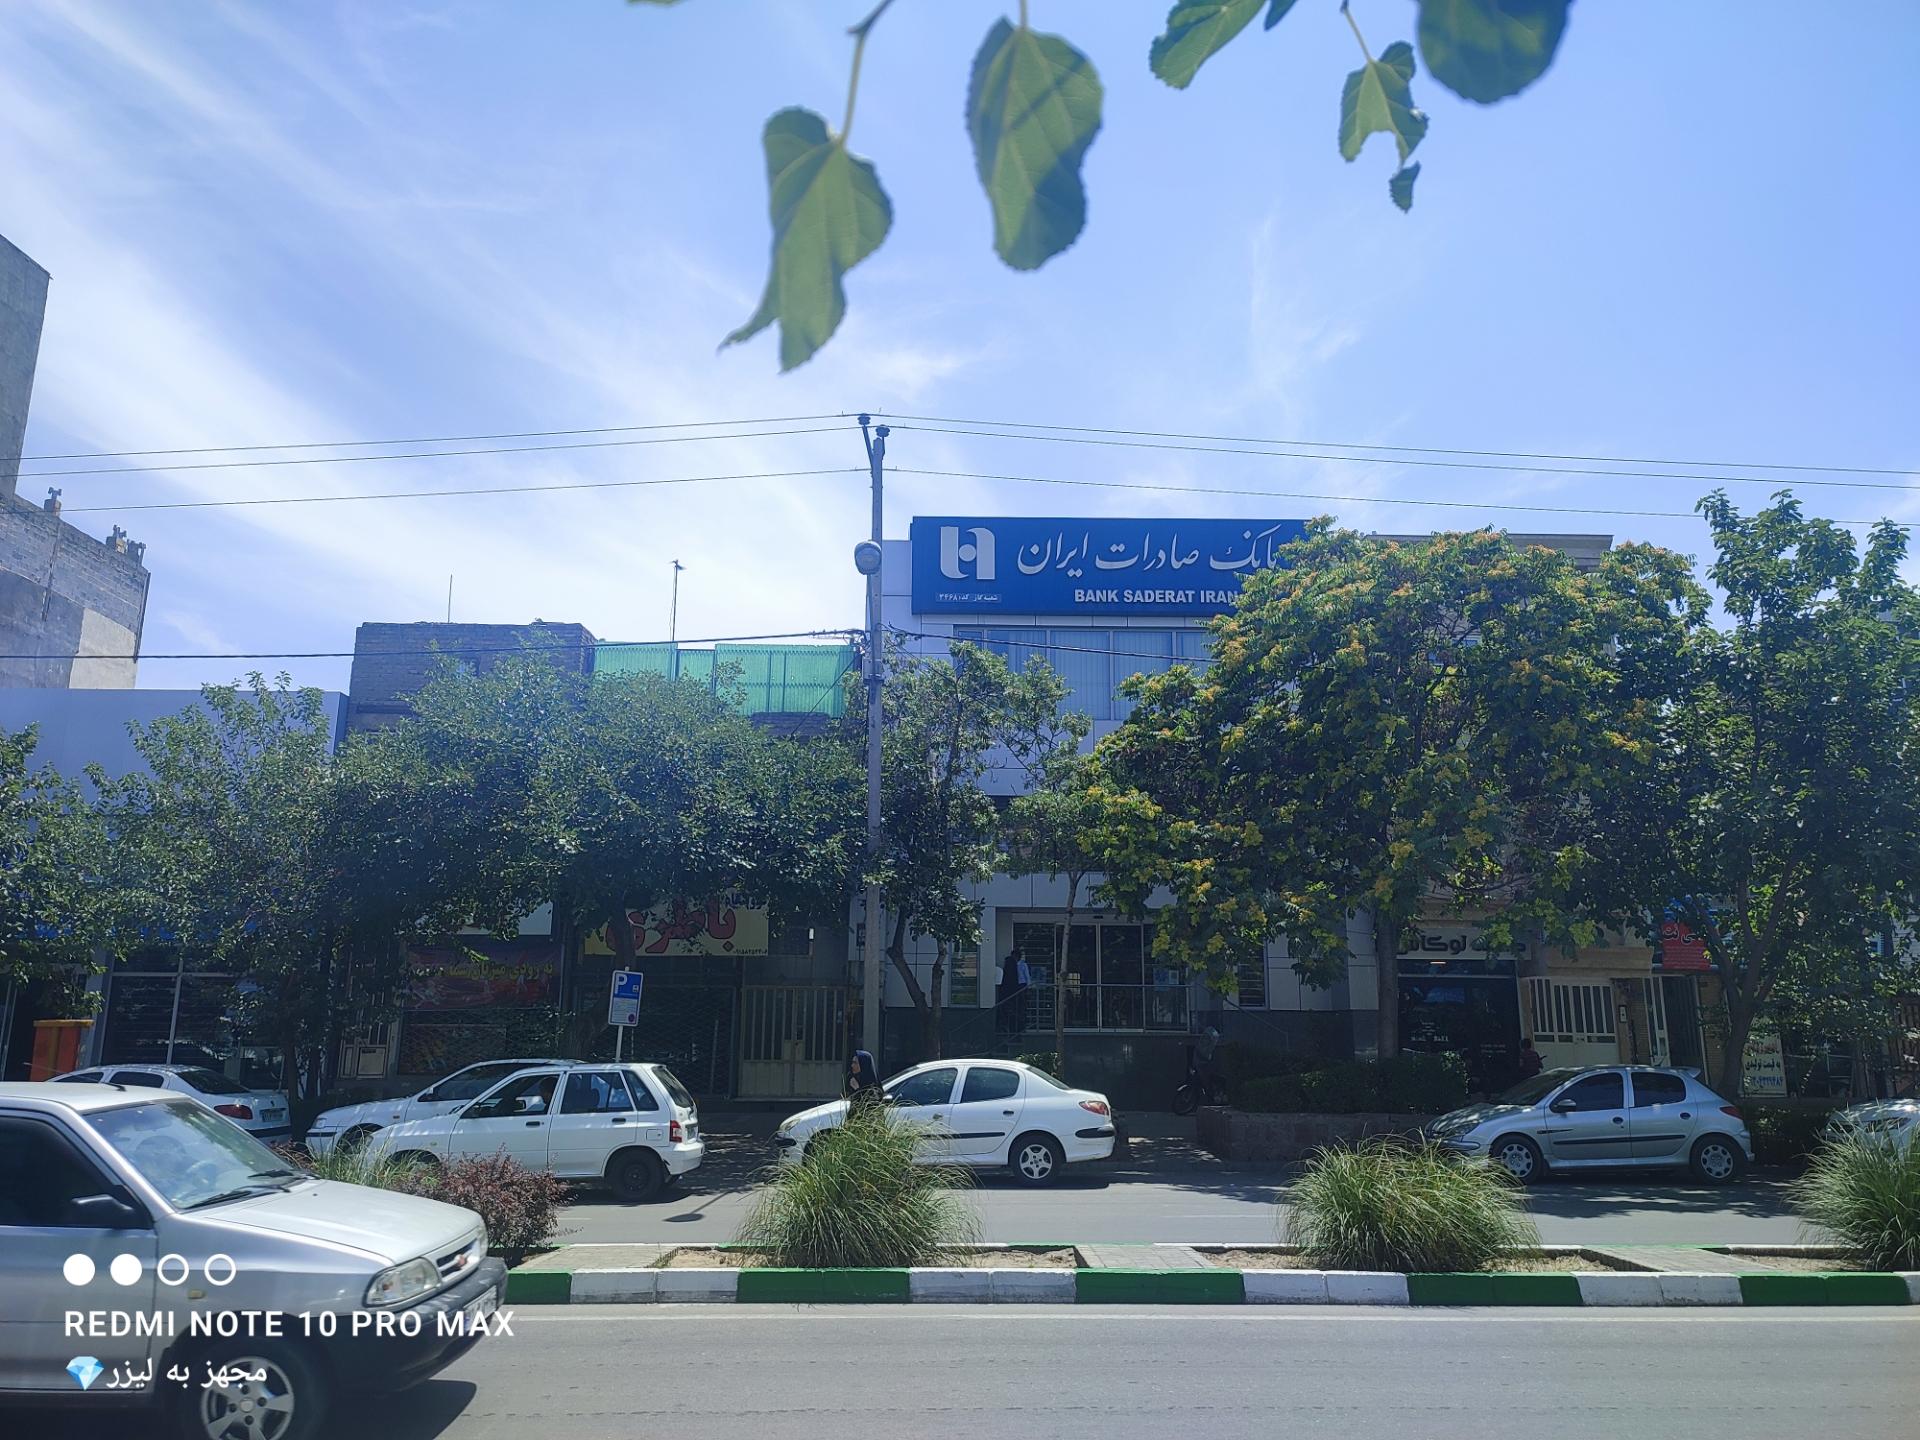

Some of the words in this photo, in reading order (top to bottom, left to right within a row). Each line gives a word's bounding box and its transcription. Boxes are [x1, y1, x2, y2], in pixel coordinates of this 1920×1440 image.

[1017, 532, 1089, 578] ایران
[1095, 532, 1200, 571] صادرات
[1074, 589, 1119, 602] BANK
[1123, 590, 1195, 603] SADERAT
[614, 973, 628, 995] P
